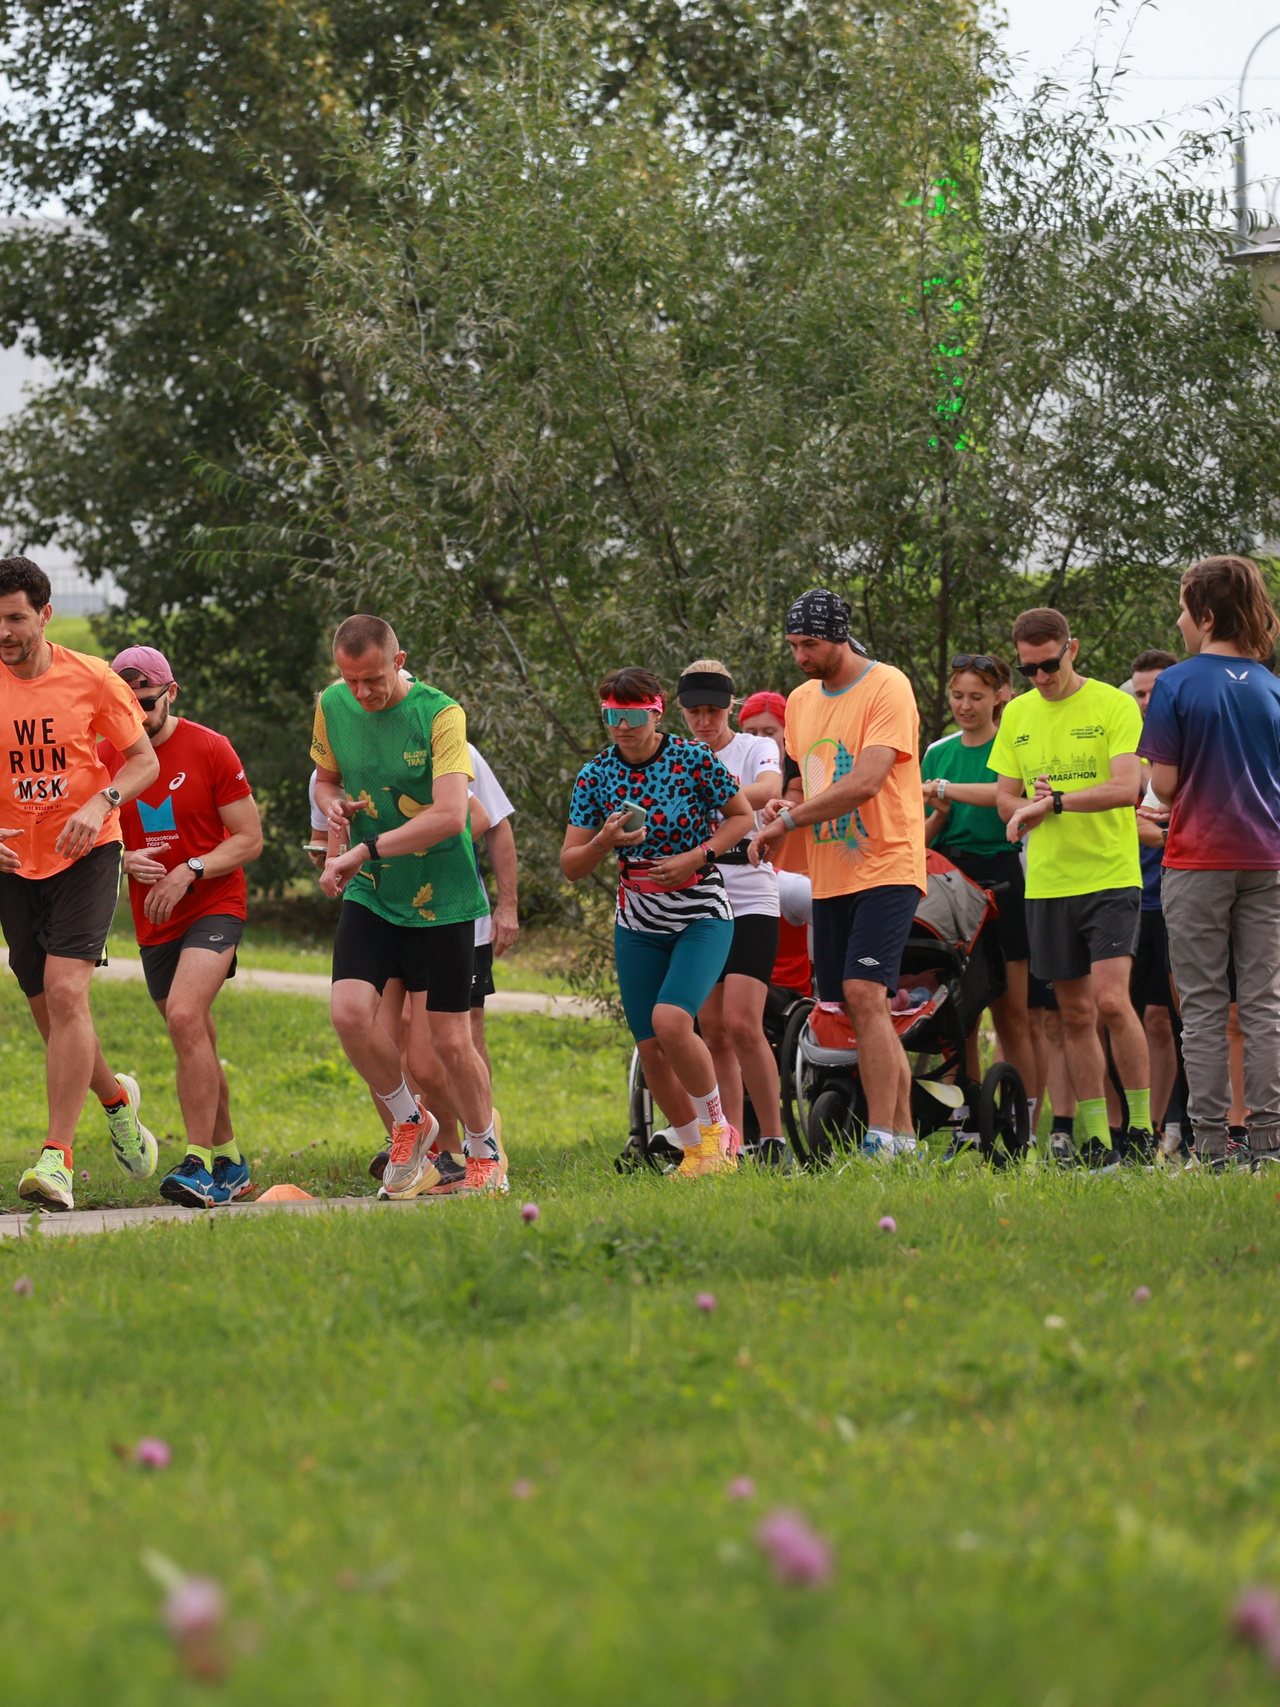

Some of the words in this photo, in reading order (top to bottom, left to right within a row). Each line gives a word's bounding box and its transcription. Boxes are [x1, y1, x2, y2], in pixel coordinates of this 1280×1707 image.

[13, 718, 56, 745] WE
[9, 747, 66, 774] RUN
[19, 778, 62, 799] MSK
[1048, 771, 1097, 782] MARATHON
